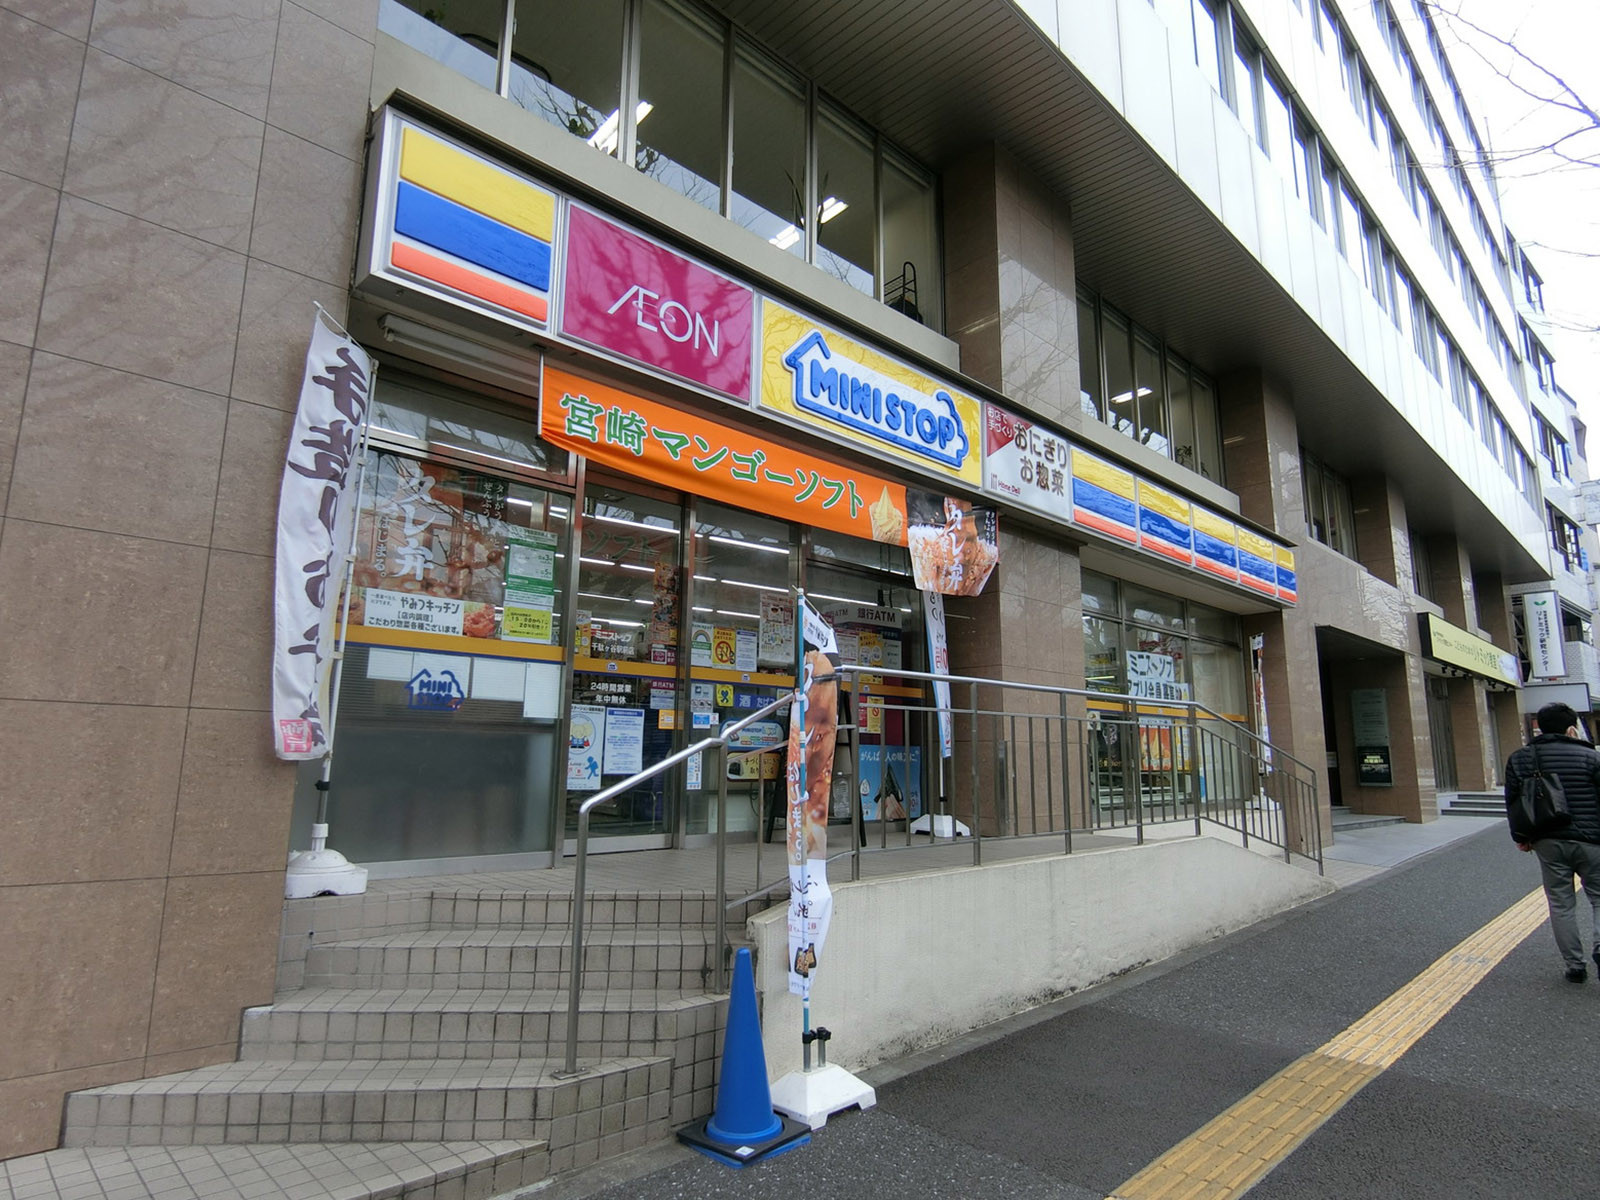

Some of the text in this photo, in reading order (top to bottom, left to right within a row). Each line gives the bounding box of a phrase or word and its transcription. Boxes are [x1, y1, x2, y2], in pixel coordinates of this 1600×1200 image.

[1013, 422, 1068, 469] おにぎり
[560, 394, 864, 519] 宮崎マンゴーソフト
[1019, 455, 1065, 497] お惣菜
[400, 596, 461, 614] やみつキッチン
[857, 607, 896, 623] 銀行ATM
[368, 617, 461, 635] こだわり惣菜各種ございます。
[418, 679, 453, 693] MINI
[590, 682, 632, 693] 24時間営業
[594, 695, 627, 705] 年中無休
[739, 694, 751, 707] 酒
